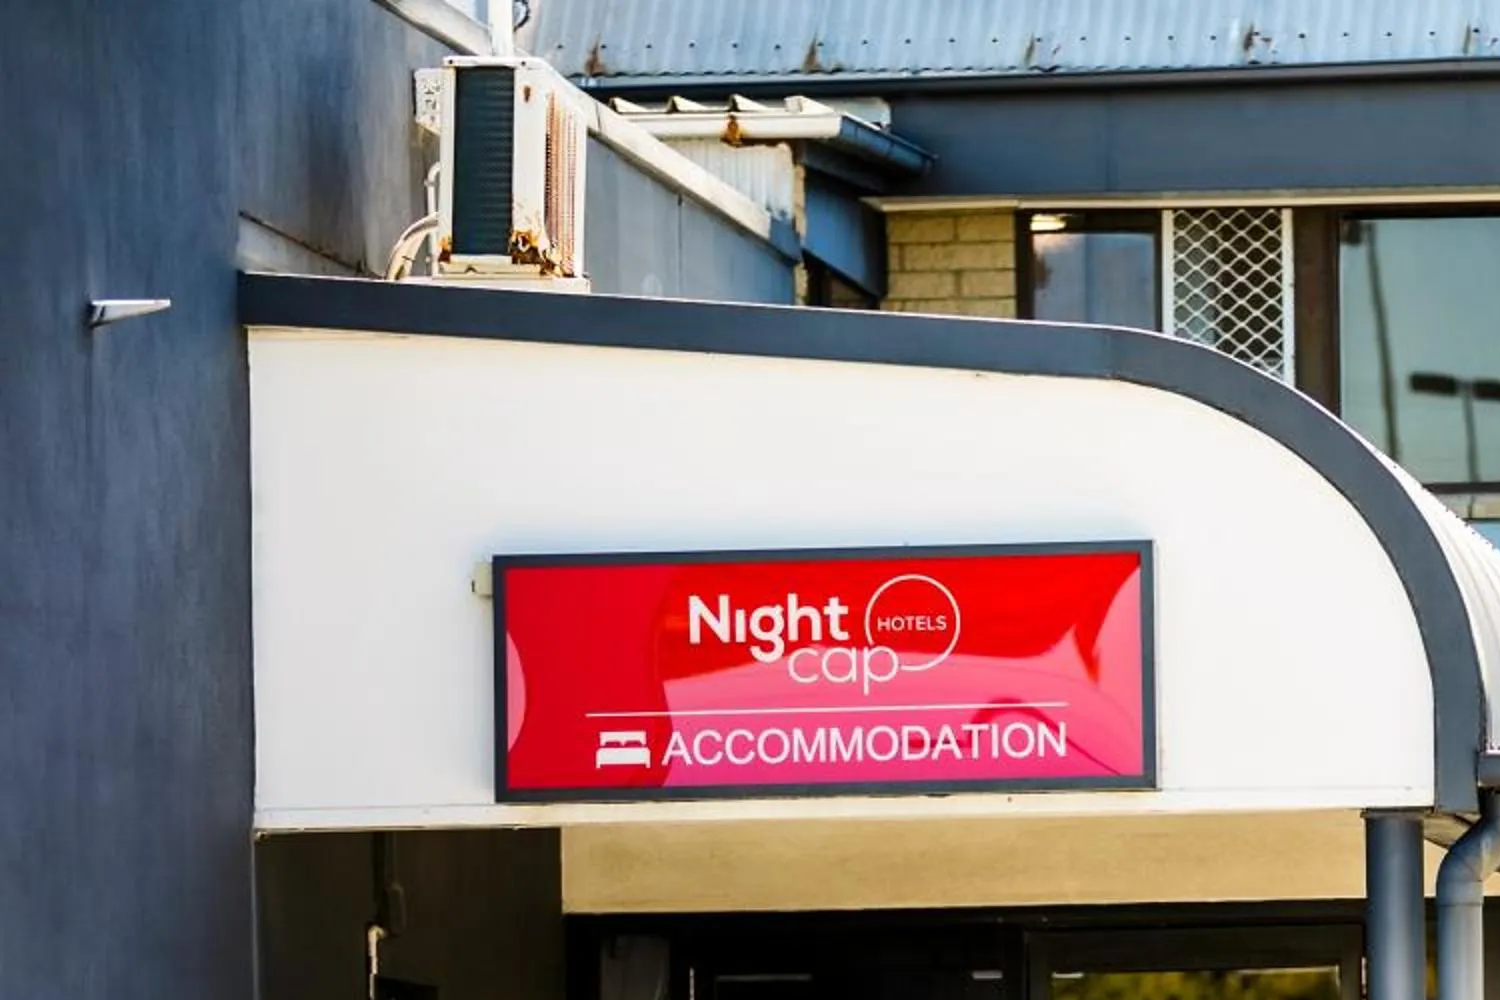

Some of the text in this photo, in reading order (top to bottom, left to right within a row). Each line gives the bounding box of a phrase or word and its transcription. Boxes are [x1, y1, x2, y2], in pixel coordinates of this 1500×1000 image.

[688, 592, 849, 663] Night
[876, 615, 947, 633] HOTELS
[788, 645, 899, 695] cap
[662, 721, 1068, 767] ACCOMMODATION
